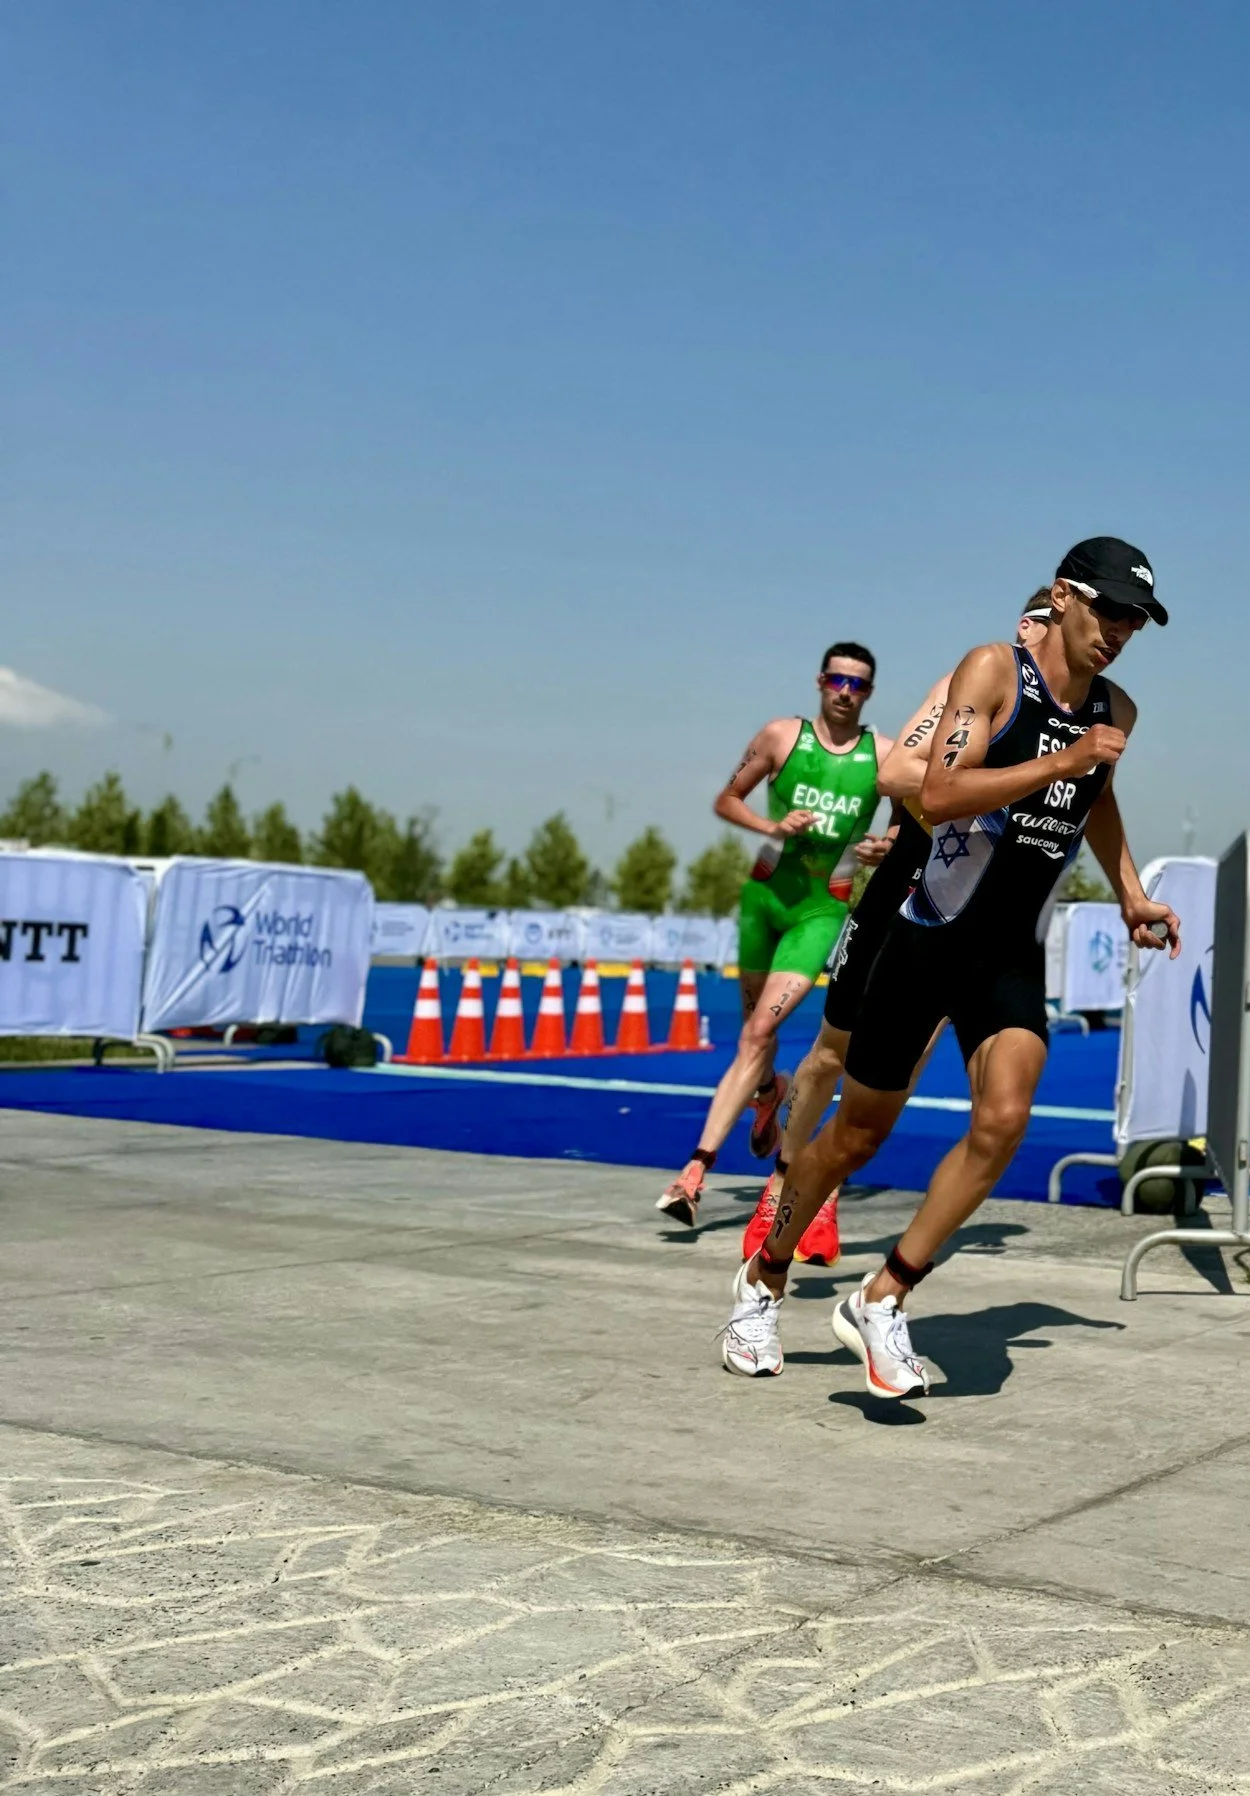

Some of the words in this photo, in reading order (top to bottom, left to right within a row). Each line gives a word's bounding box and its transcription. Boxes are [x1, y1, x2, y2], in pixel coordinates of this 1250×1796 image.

[792, 783, 862, 816] EDGAR
[1043, 779, 1077, 810] ISR
[807, 810, 840, 838] RL
[1016, 834, 1060, 852] saucony
[255, 911, 314, 937] World
[252, 939, 332, 969] Triathlon
